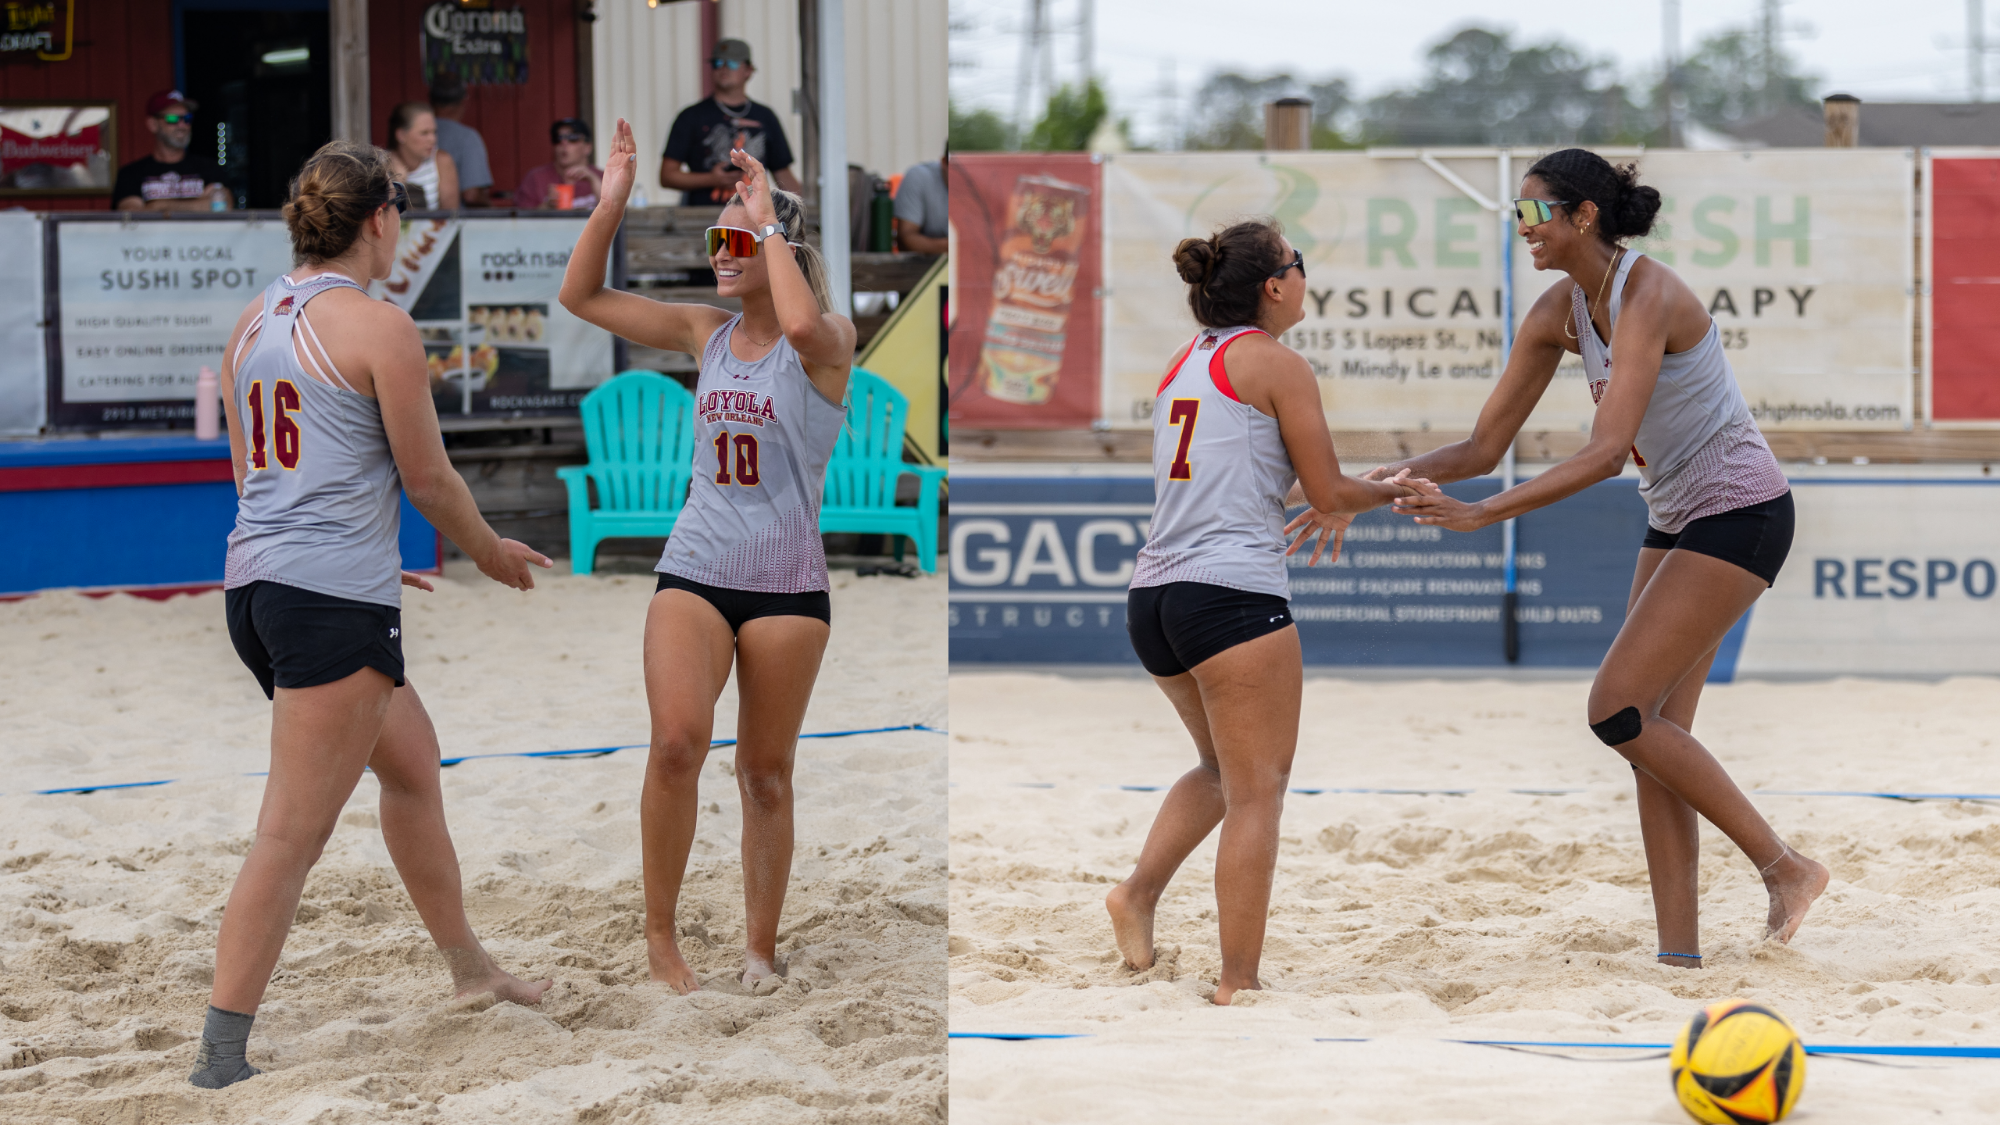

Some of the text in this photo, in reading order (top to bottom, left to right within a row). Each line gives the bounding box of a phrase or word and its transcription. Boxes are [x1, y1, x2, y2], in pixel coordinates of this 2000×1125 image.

[425, 3, 525, 39] Corona
[452, 36, 502, 54] Extra
[122, 246, 235, 262] YOUR LOCAL
[481, 247, 527, 268] rock
[531, 252, 542, 267] n
[101, 268, 257, 290] SUSHI SPOT
[1308, 287, 1516, 319] YSICAL
[76, 315, 212, 328] HIGH QUALITY SUSHI
[76, 346, 111, 357] EASY
[114, 345, 164, 358] ONLINE
[1341, 329, 1357, 350] S
[1363, 330, 1426, 354] Lopez
[1340, 357, 1409, 384] Mindy
[1418, 358, 1441, 378] Le
[1450, 358, 1493, 378] and
[78, 375, 145, 388] CATERING
[149, 375, 174, 387] FOR
[138, 405, 197, 419] METAIRI
[699, 388, 778, 423] LOYOLA
[247, 379, 301, 471] 16
[706, 412, 764, 427] NEW ORLEANS
[1168, 398, 1201, 481] 7
[713, 431, 760, 487] 10
[1346, 525, 1394, 541] BUILD
[1397, 525, 1442, 541] OUTS
[1353, 552, 1482, 568] CONSTRUCTION
[1813, 559, 1997, 600] RESPO
[1291, 605, 1603, 623] OMMERCIAL STOREFRONT UILD OUTS
